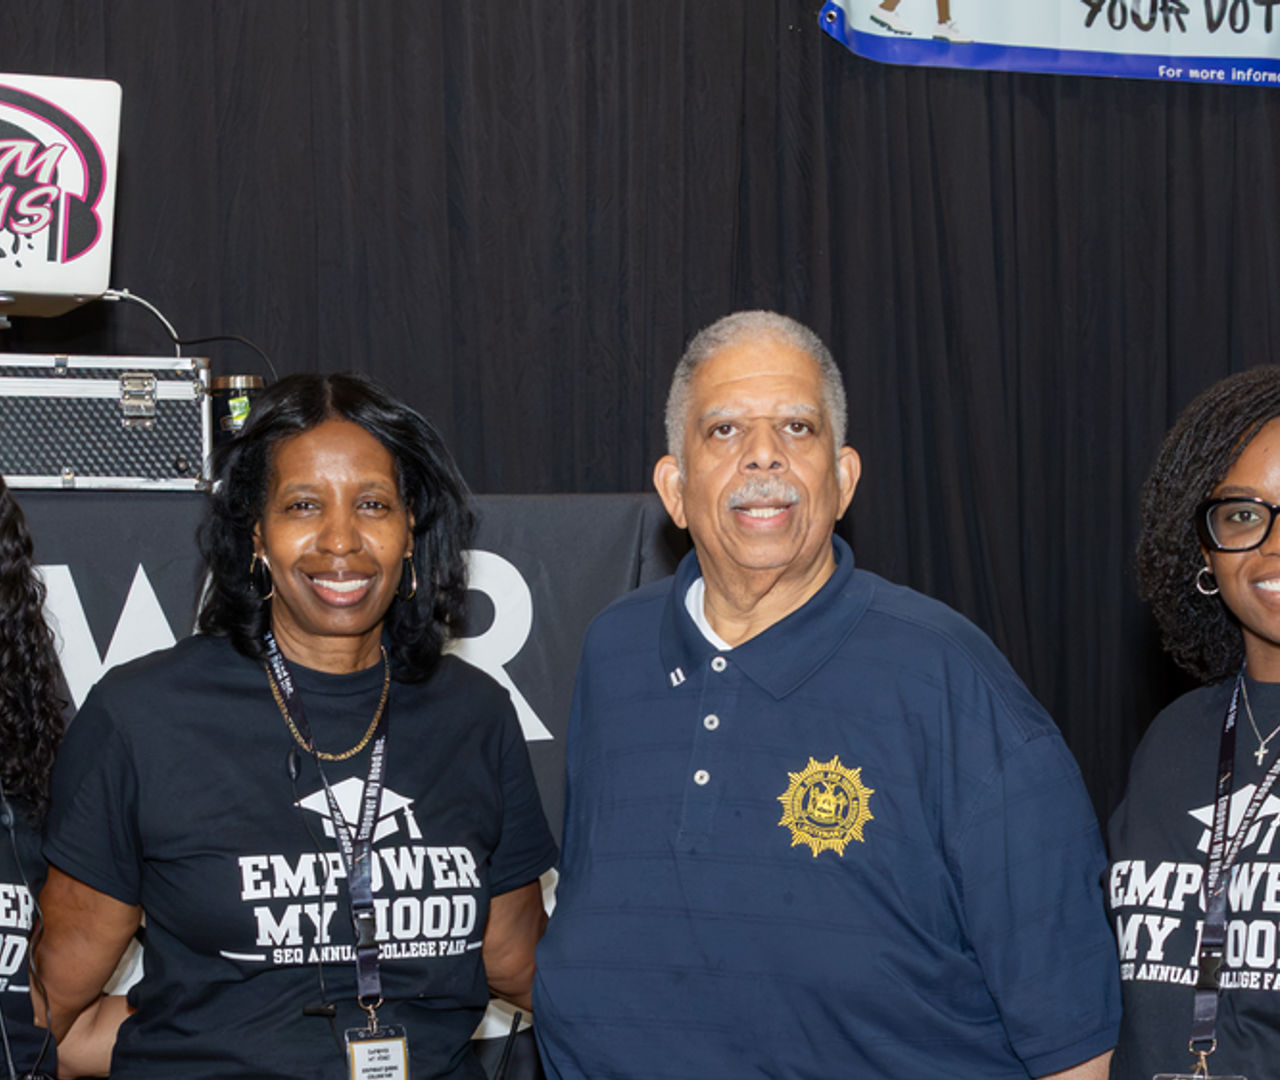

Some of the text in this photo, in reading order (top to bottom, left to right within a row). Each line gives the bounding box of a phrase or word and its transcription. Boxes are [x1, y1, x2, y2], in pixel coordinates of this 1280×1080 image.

[1082, 0, 1191, 33] YOUR
[1158, 65, 1185, 79] For
[1189, 68, 1225, 81] more
[254, 902, 338, 946] MY
[273, 948, 303, 964] SEQ
[308, 946, 357, 963] ANNUA
